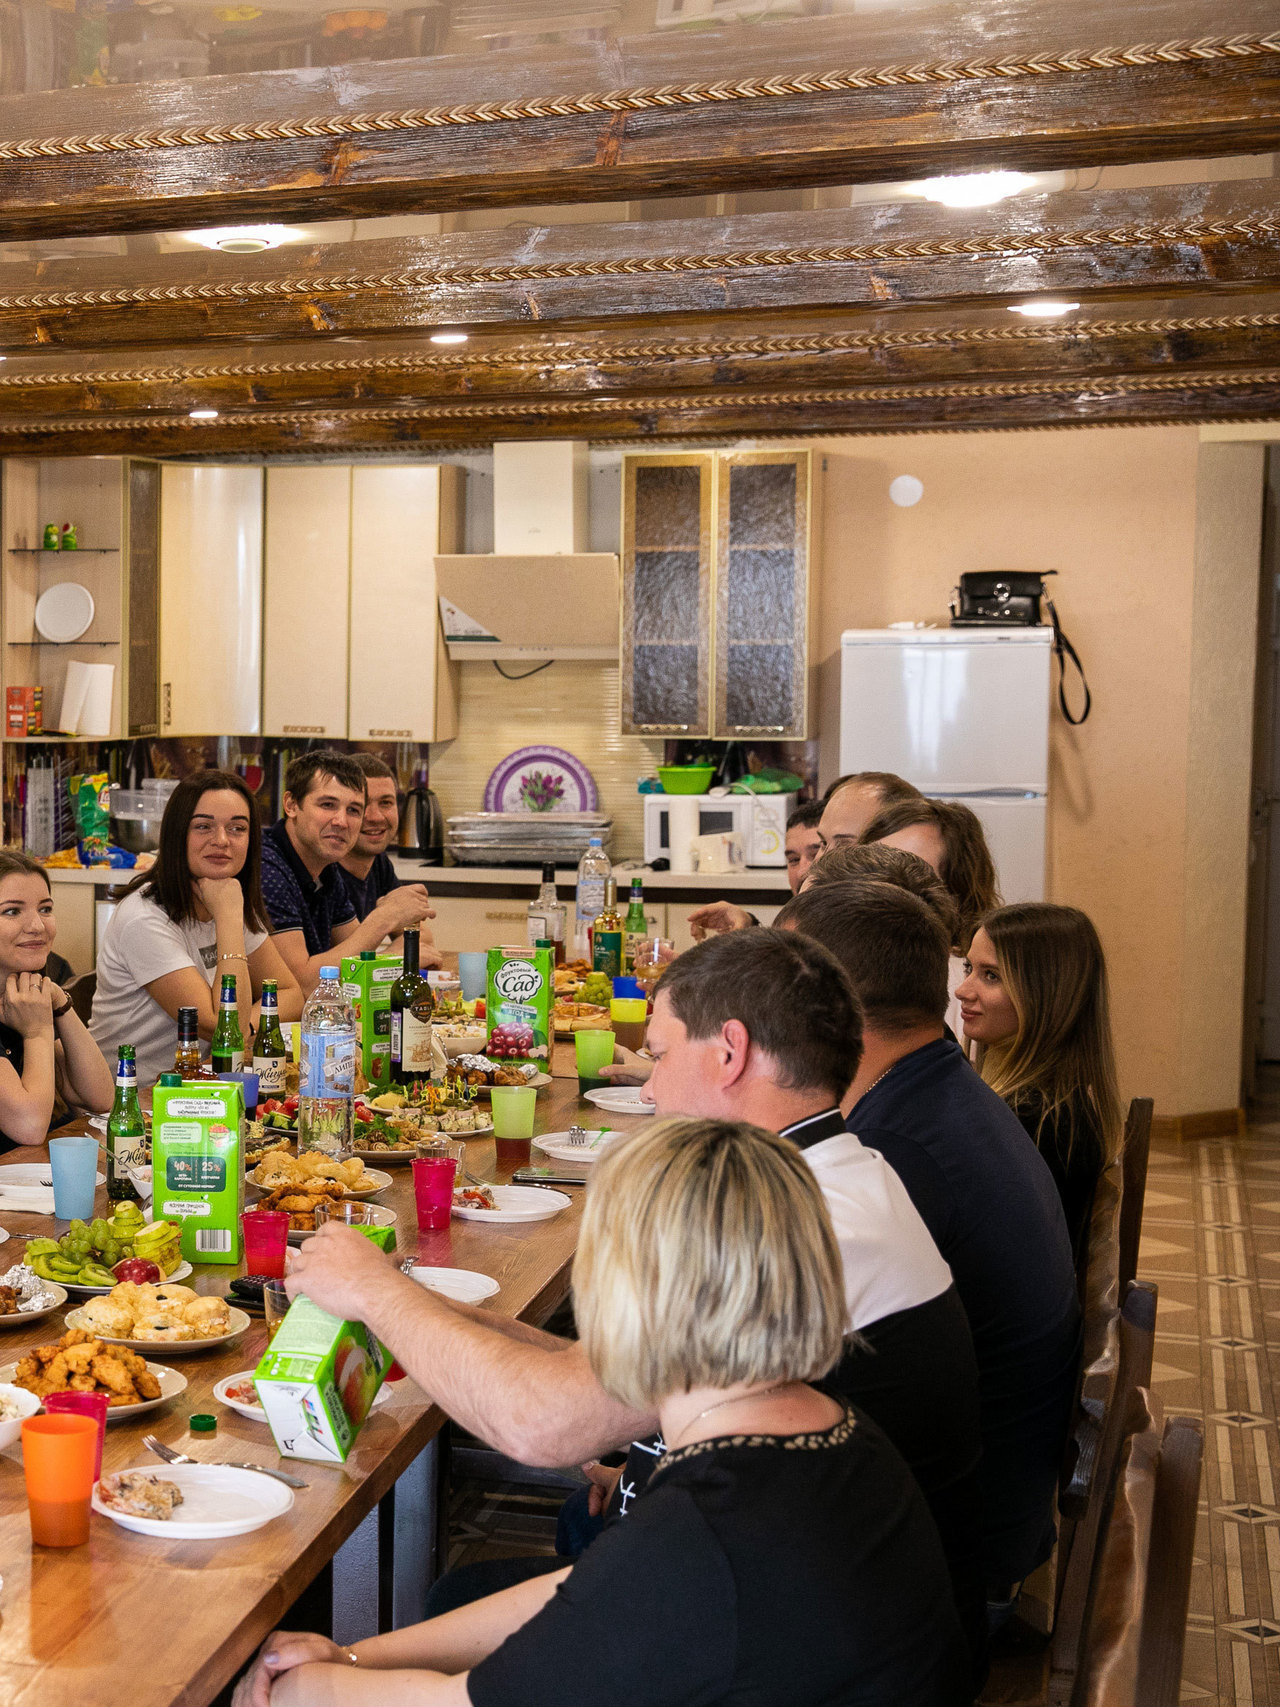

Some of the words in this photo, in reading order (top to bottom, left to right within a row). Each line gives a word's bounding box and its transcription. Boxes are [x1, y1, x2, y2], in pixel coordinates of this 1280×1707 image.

[501, 968, 531, 978] фруктовый
[503, 974, 534, 992] Сад
[174, 1160, 192, 1171] 40%
[201, 1161, 221, 1172] 25%
